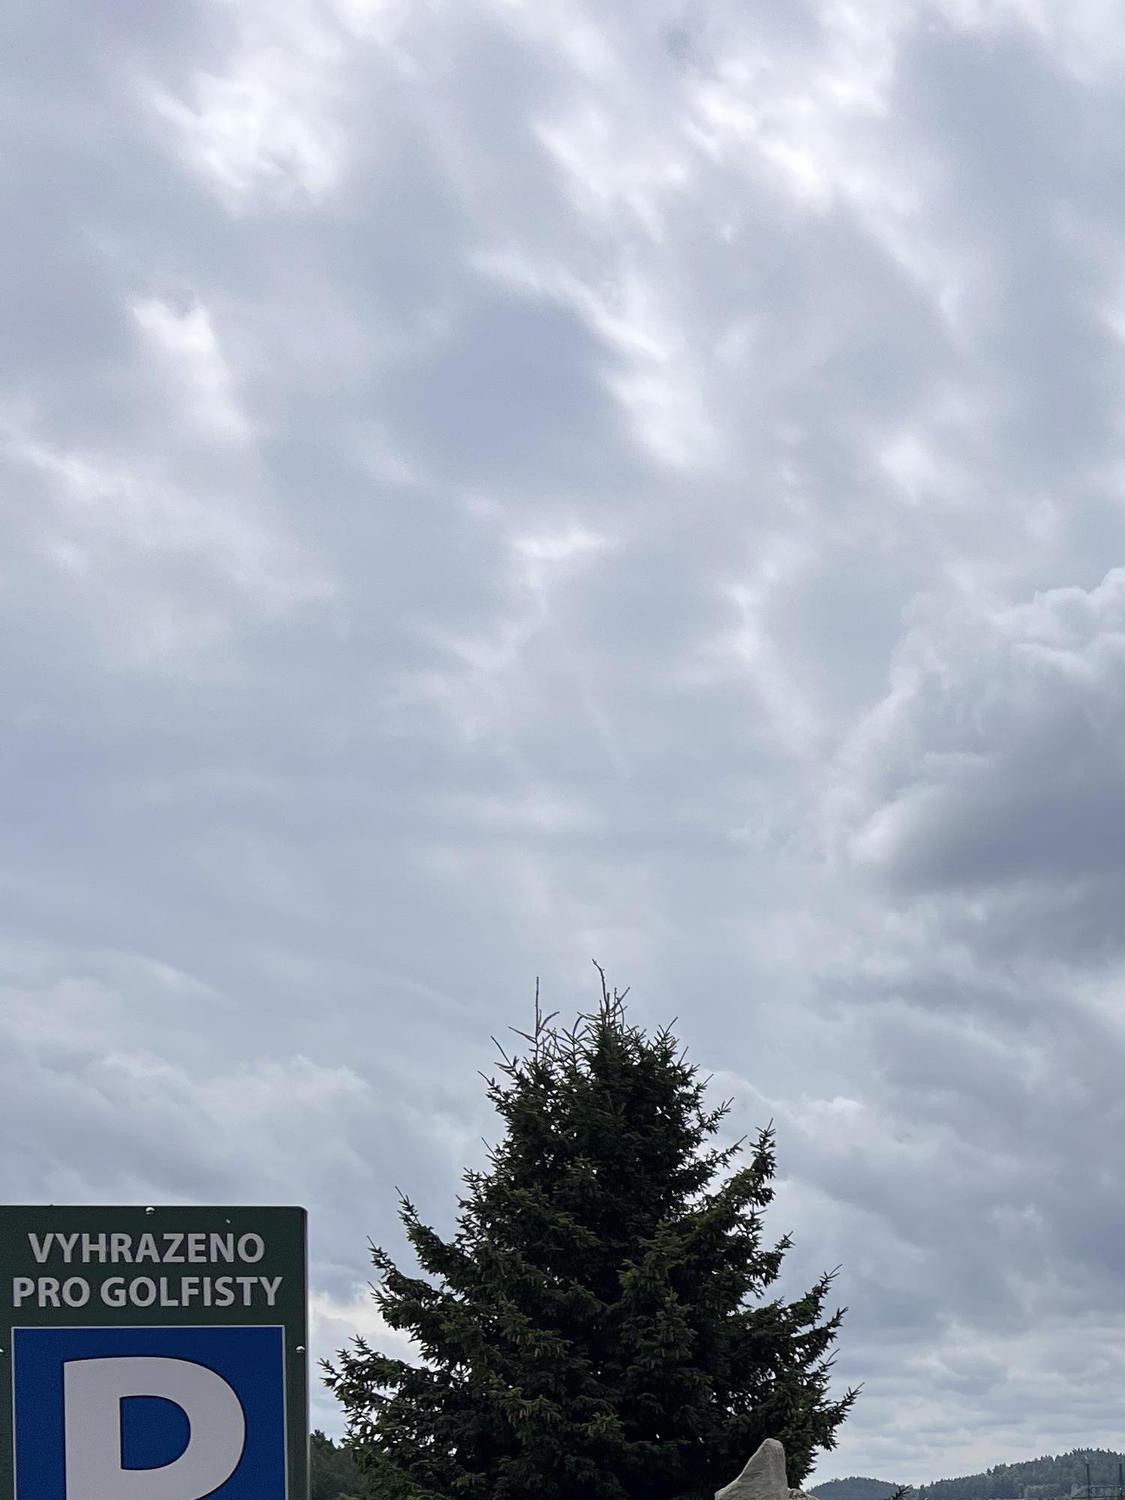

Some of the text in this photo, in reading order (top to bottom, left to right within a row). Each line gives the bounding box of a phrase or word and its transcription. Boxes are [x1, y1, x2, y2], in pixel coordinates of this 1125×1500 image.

[27, 1231, 266, 1265] VYHRAZENO
[12, 1275, 284, 1309] PRO GOLFISTY
